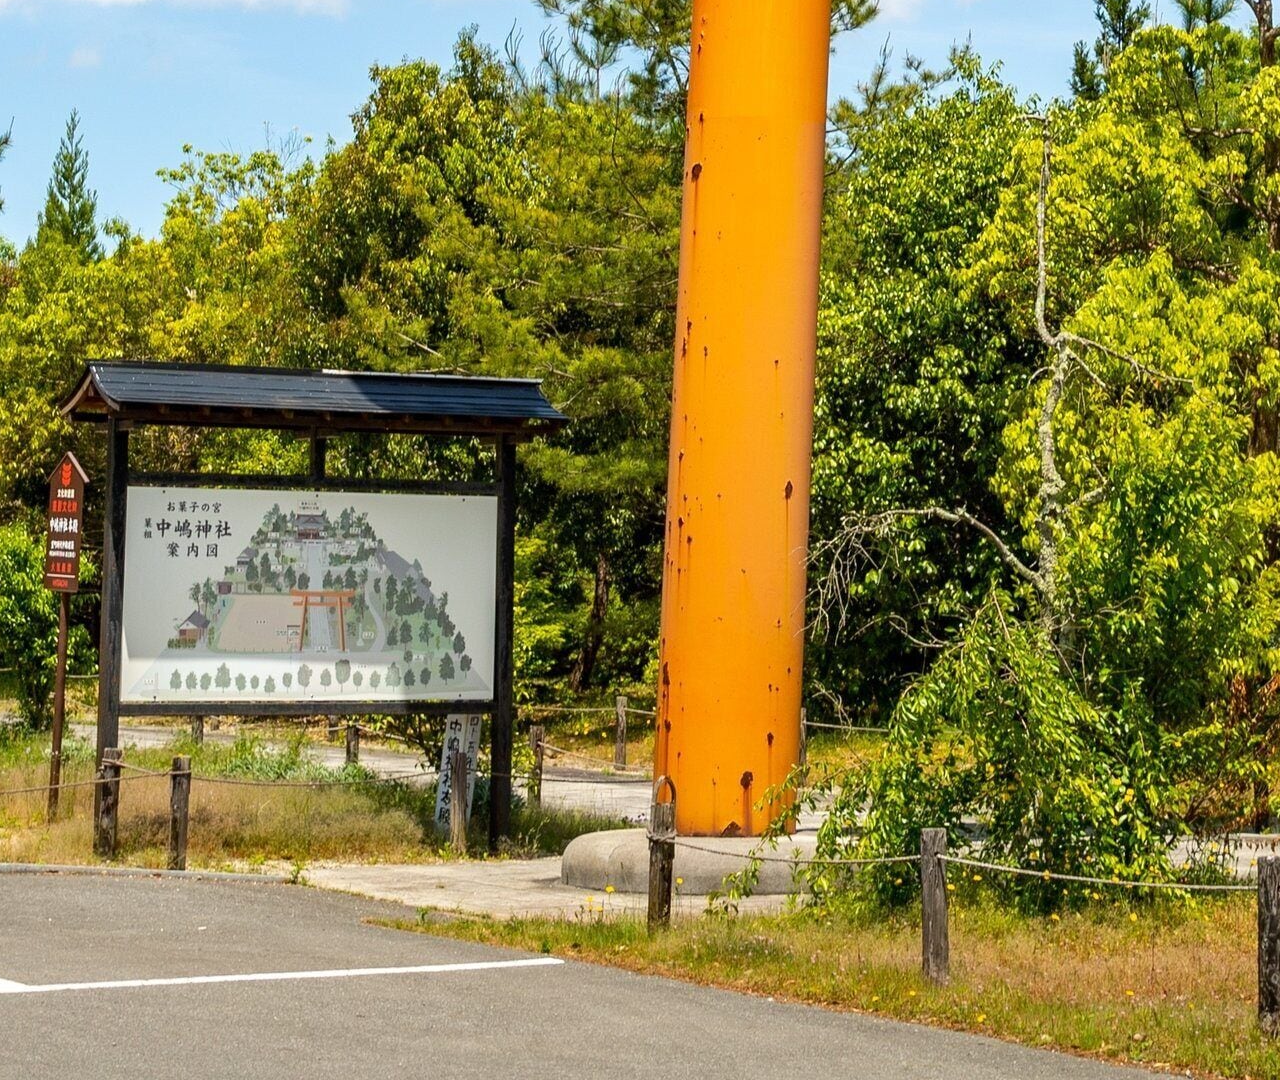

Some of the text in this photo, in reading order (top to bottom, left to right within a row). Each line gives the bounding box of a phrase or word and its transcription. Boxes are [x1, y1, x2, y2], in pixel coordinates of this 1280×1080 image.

[167, 500, 222, 514] お菓子の宮
[156, 518, 232, 540] 中嶋神社
[166, 541, 219, 559] 案内図
